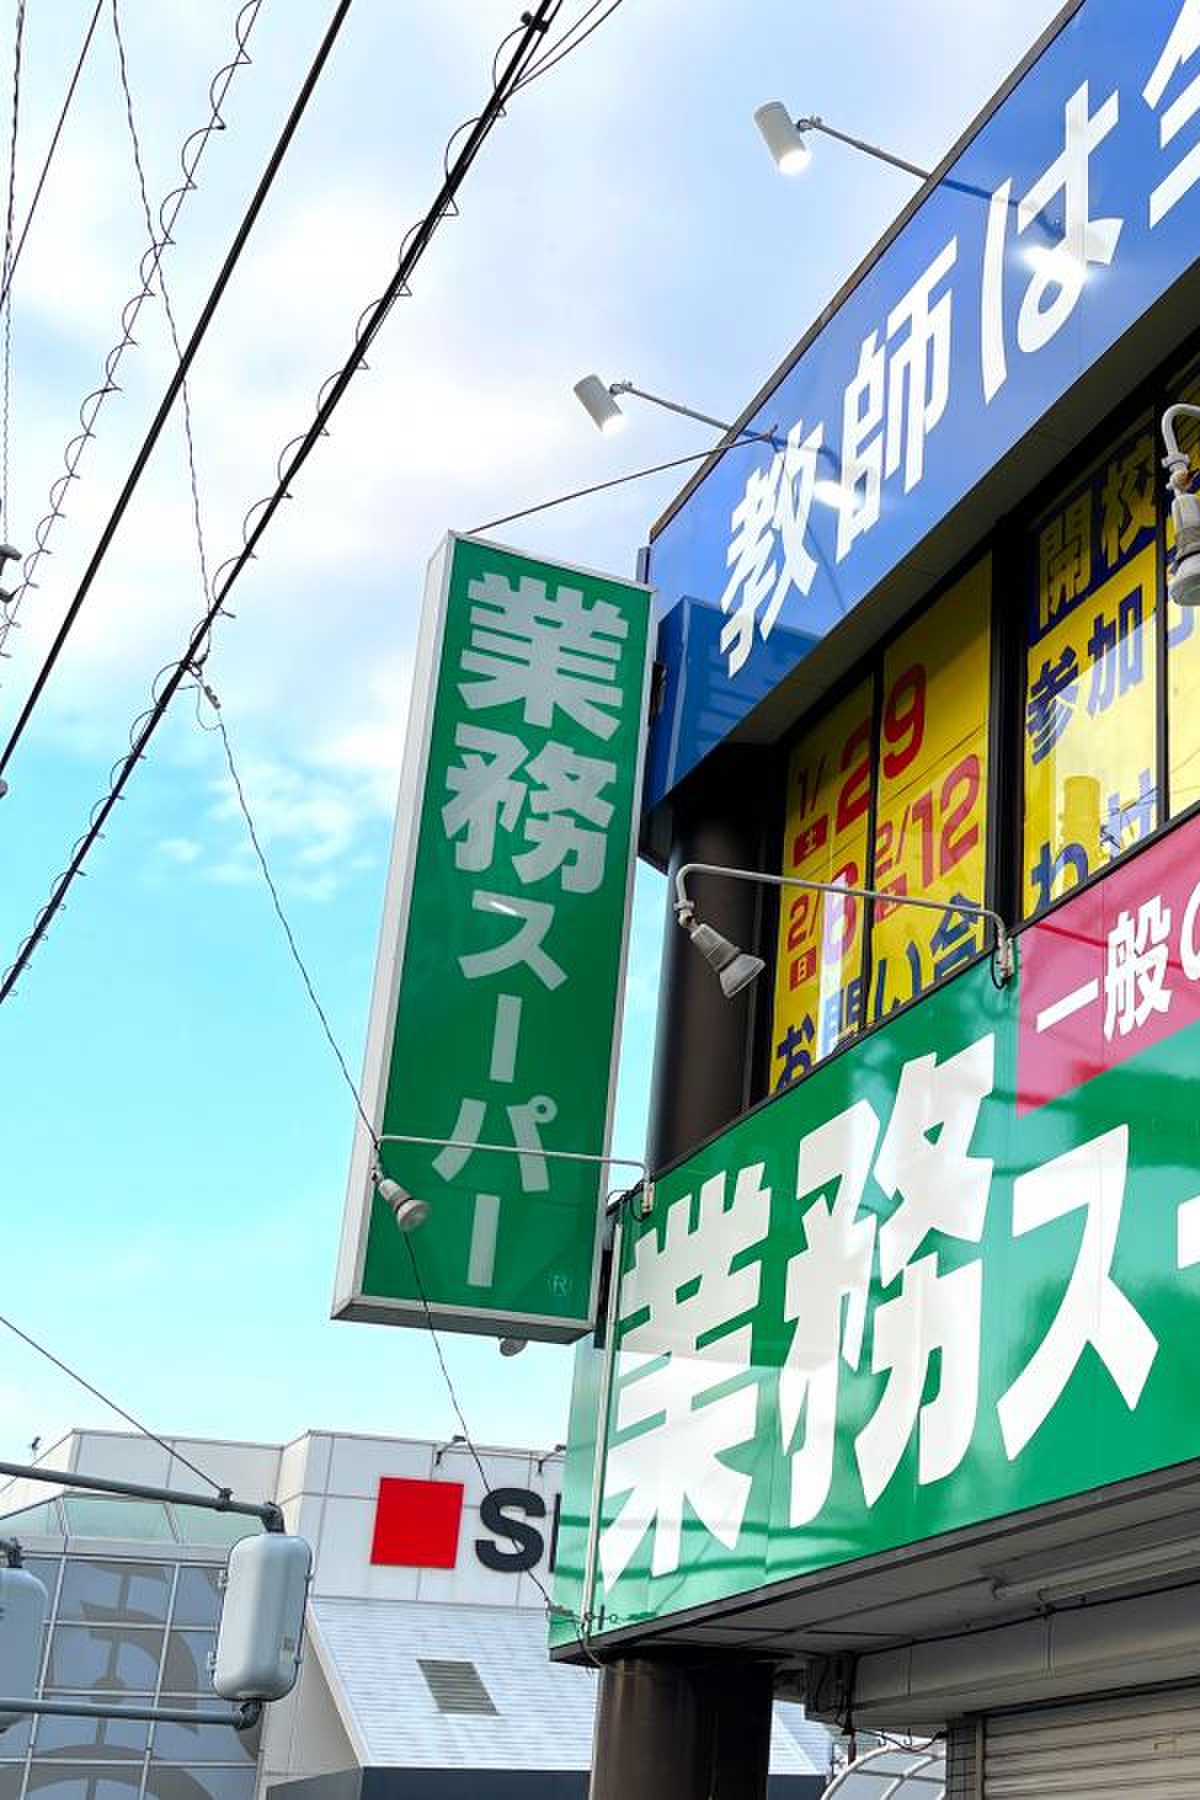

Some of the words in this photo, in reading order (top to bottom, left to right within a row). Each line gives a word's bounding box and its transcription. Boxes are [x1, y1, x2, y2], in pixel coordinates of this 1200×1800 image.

[433, 571, 630, 1288] 業務スーパー
[475, 1487, 562, 1574] S
